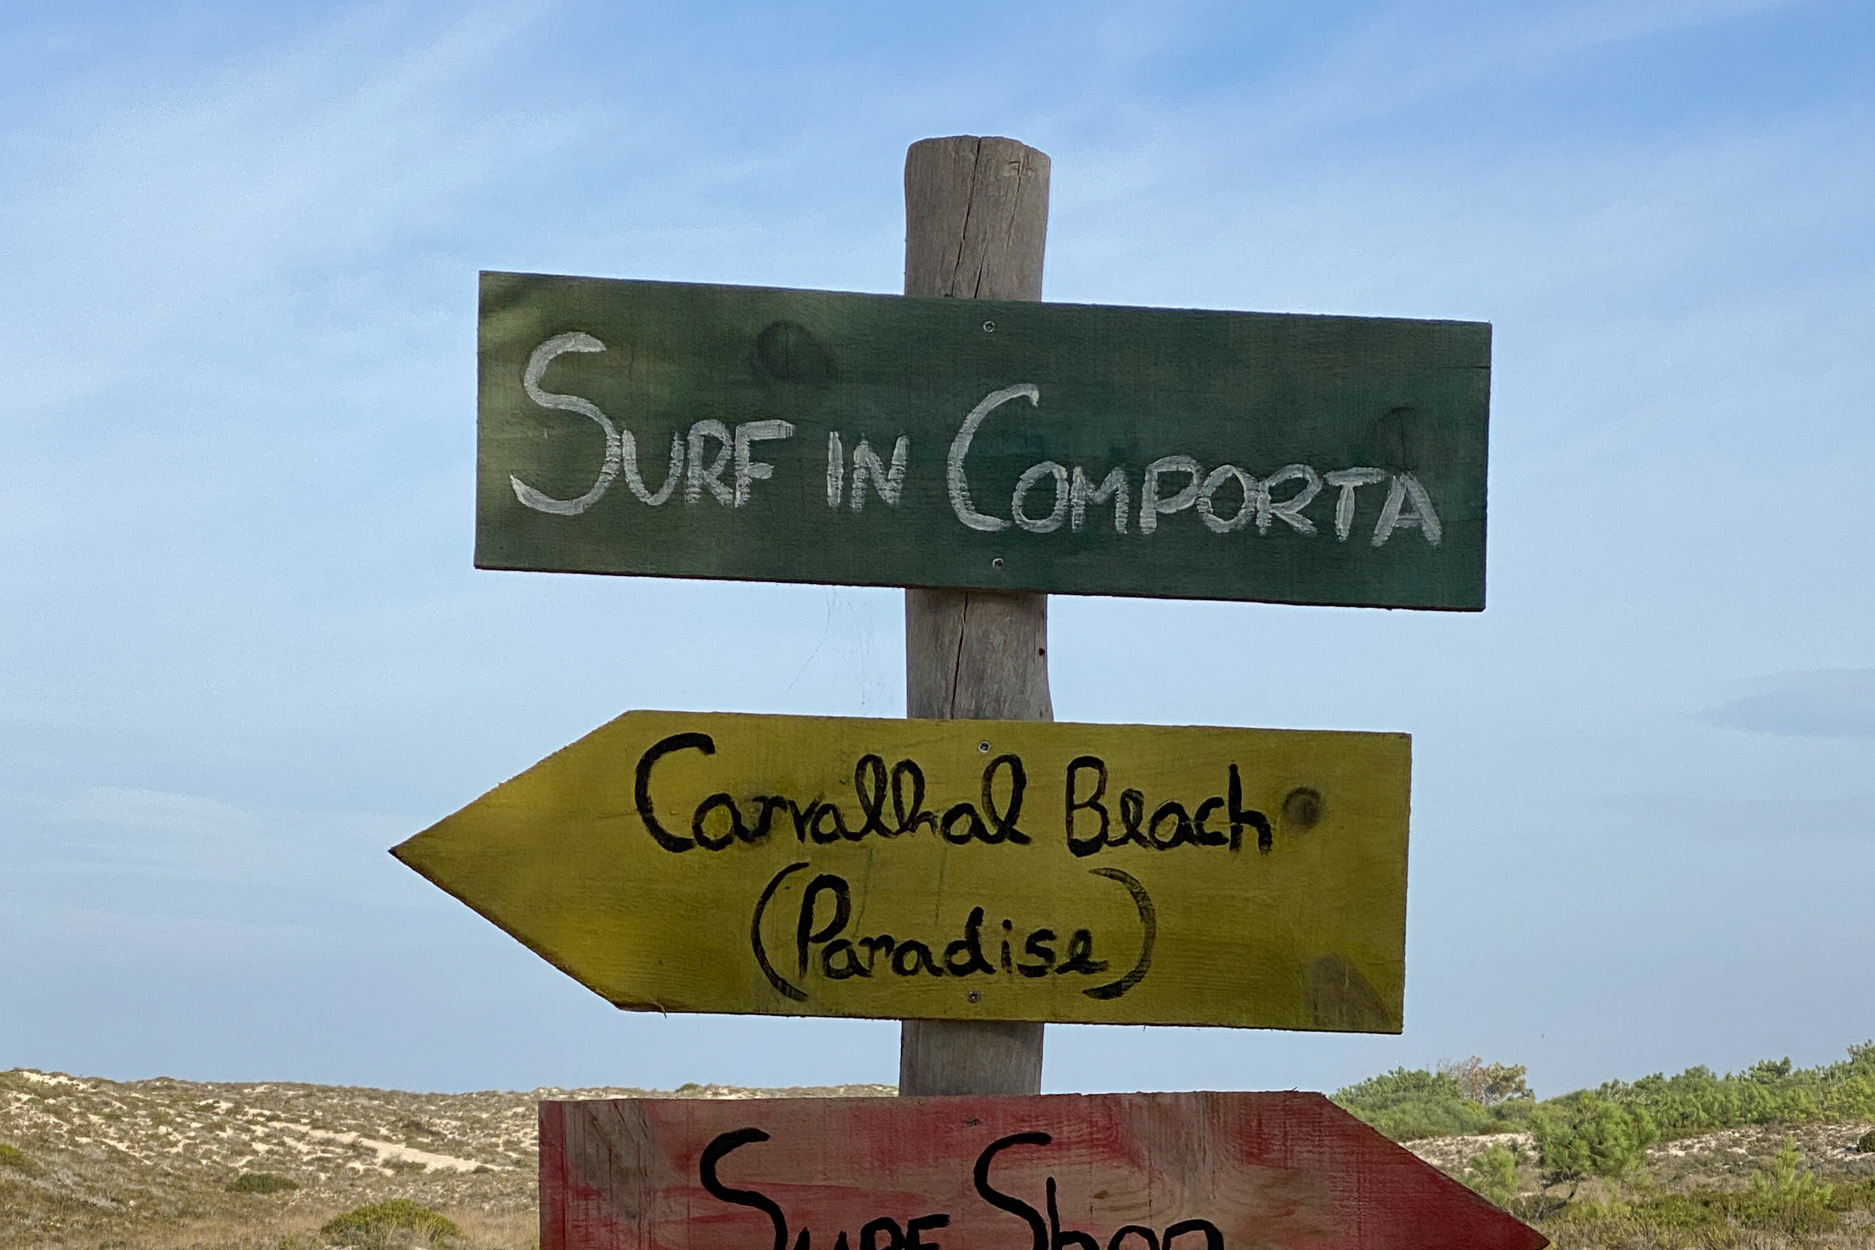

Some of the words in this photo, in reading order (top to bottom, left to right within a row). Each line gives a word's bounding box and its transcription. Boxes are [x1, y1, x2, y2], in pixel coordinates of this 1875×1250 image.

[826, 429, 910, 514] IN
[1065, 755, 1274, 857] Beach
[749, 861, 1157, 1001] (Paradise)
